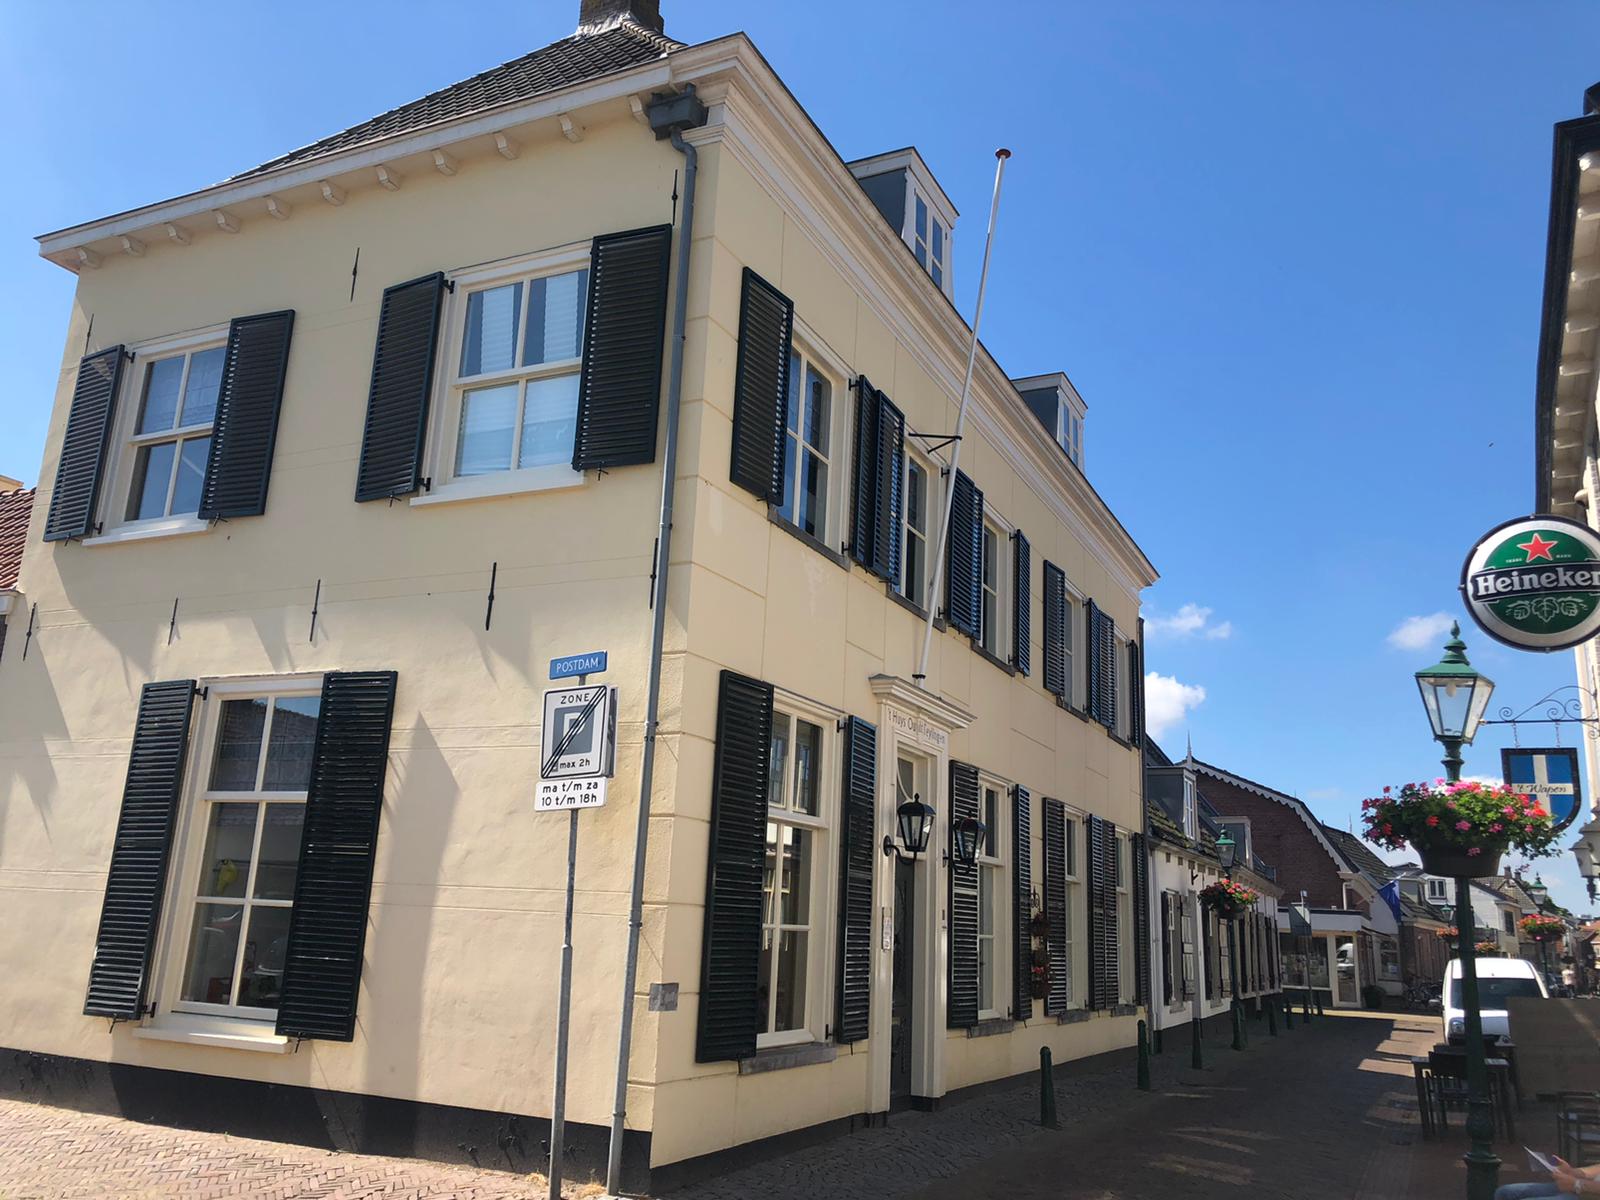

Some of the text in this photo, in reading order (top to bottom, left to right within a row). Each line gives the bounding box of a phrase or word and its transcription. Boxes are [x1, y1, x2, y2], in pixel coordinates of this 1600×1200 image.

[556, 657, 599, 673] POSTDAM
[560, 692, 590, 705] ZONE
[560, 758, 591, 769] max 2h
[543, 780, 598, 793] ma t/m za
[1526, 783, 1567, 798] Wapen
[542, 793, 597, 806] 10 t/m 18h
